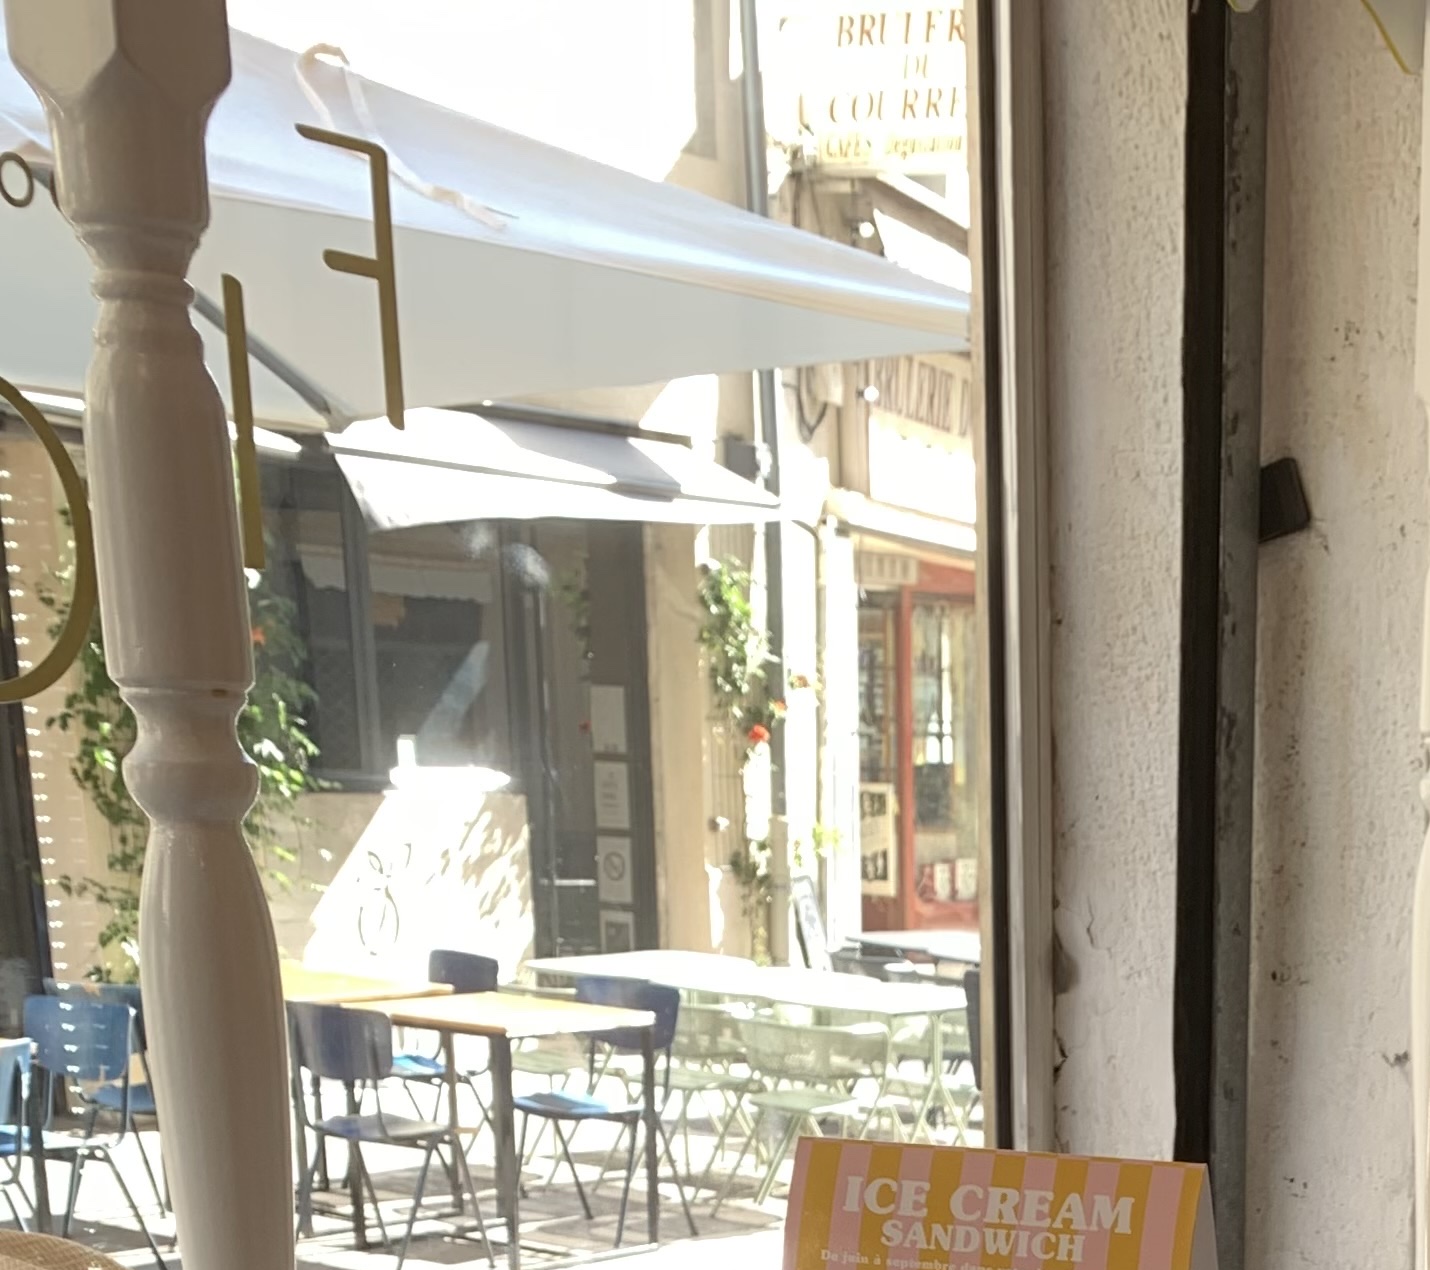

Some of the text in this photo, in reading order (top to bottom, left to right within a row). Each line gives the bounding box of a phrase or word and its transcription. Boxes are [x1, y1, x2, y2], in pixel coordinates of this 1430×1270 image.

[842, 1175, 1136, 1235] ICE CREAM
[820, 1249, 839, 1261] De
[842, 1251, 869, 1264] juin
[873, 1255, 881, 1265] à
[880, 1220, 1086, 1263] SANDWICH
